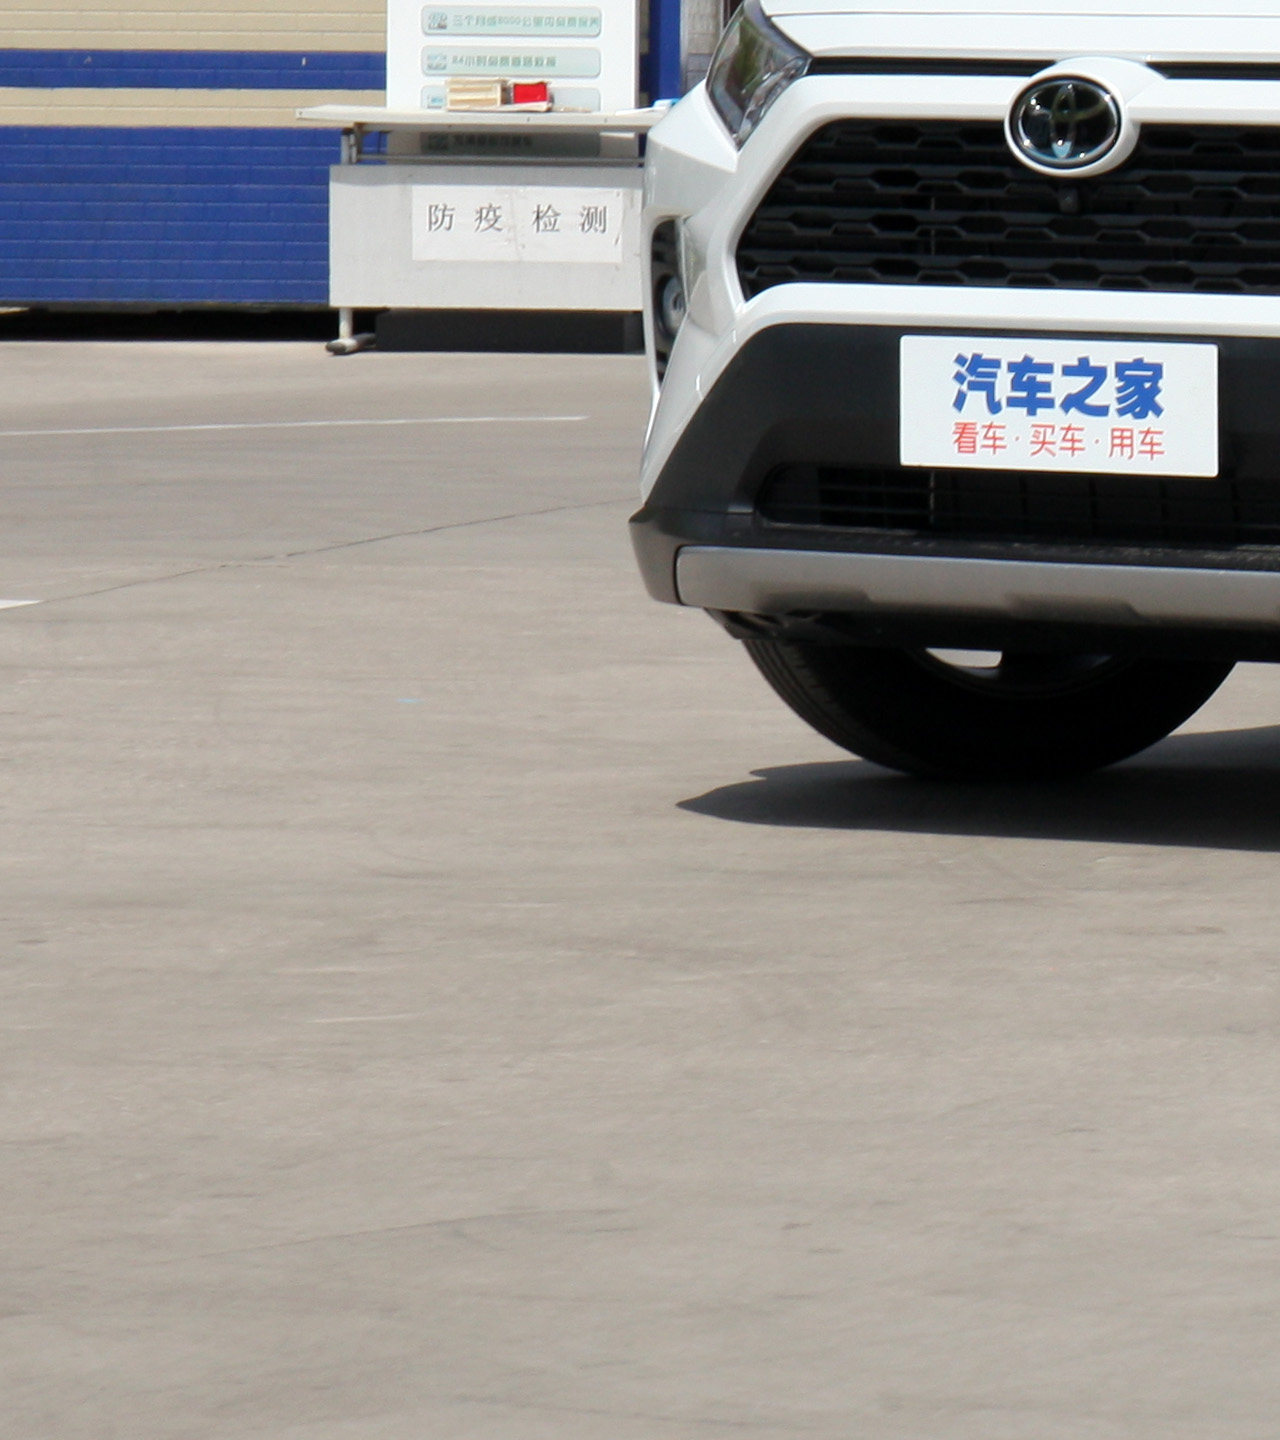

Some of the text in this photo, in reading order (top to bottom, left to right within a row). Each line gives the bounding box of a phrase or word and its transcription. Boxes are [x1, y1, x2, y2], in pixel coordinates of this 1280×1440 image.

[427, 203, 608, 234] 防疫检测
[952, 352, 1165, 420] 汽车之家
